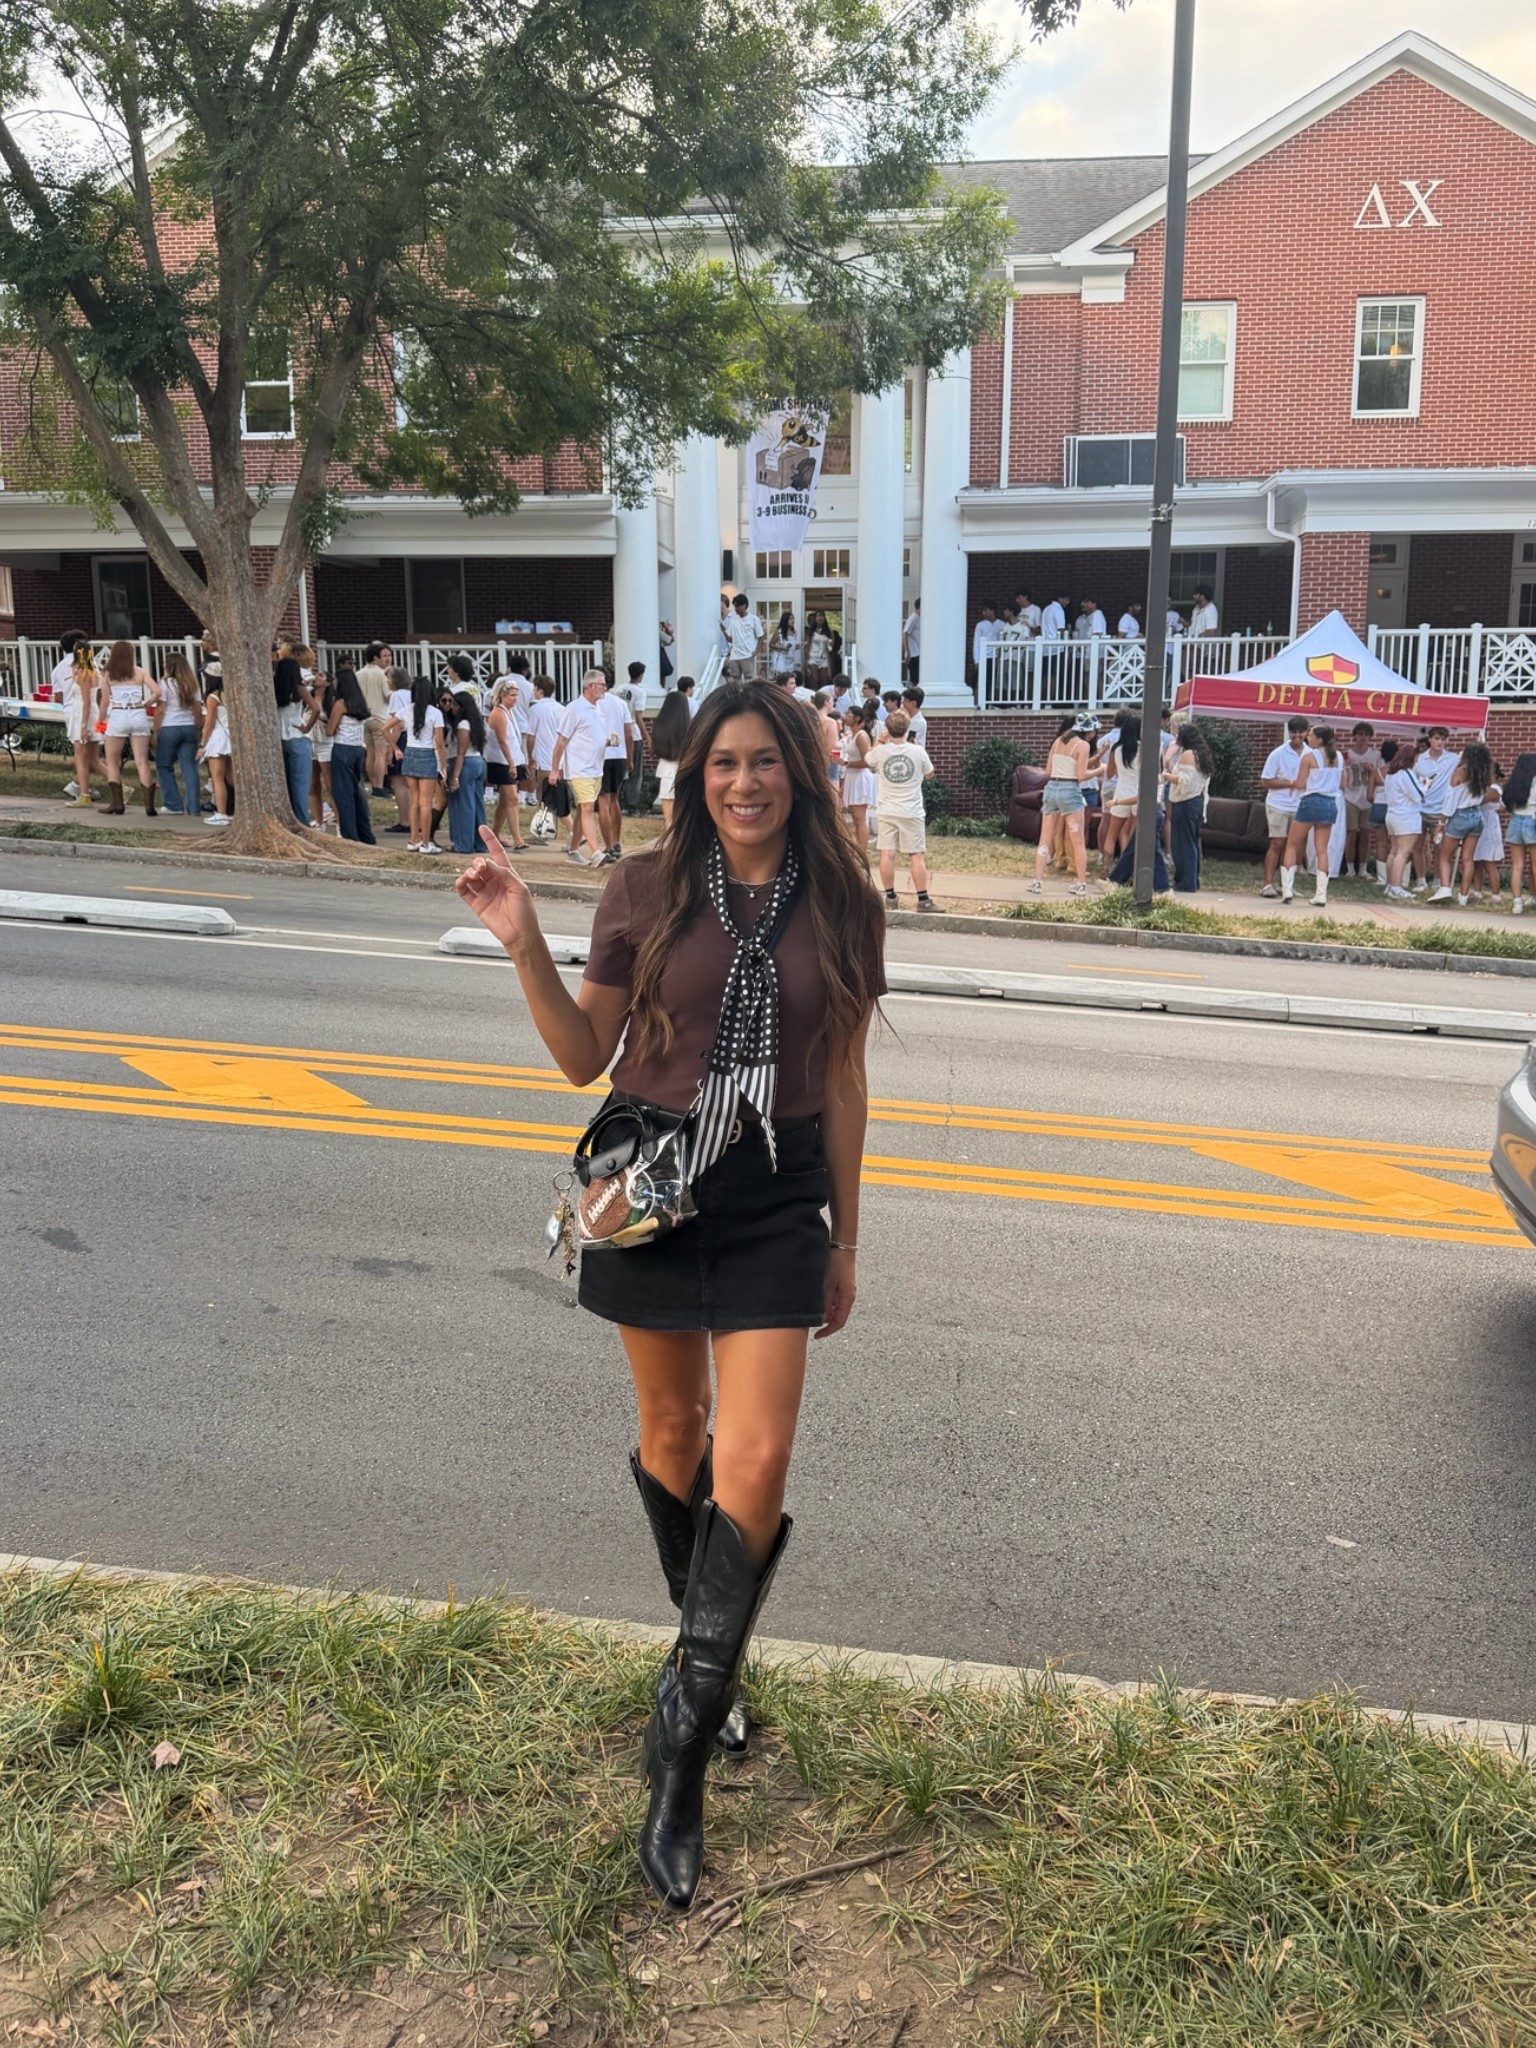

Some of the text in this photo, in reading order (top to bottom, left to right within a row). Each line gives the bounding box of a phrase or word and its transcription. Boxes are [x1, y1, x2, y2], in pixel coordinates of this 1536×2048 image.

[770, 493, 803, 505] ARRIVES
[756, 505, 771, 517] 3-9
[772, 503, 807, 516] BUSINESS
[1256, 682, 1421, 716] DELTA CHI
